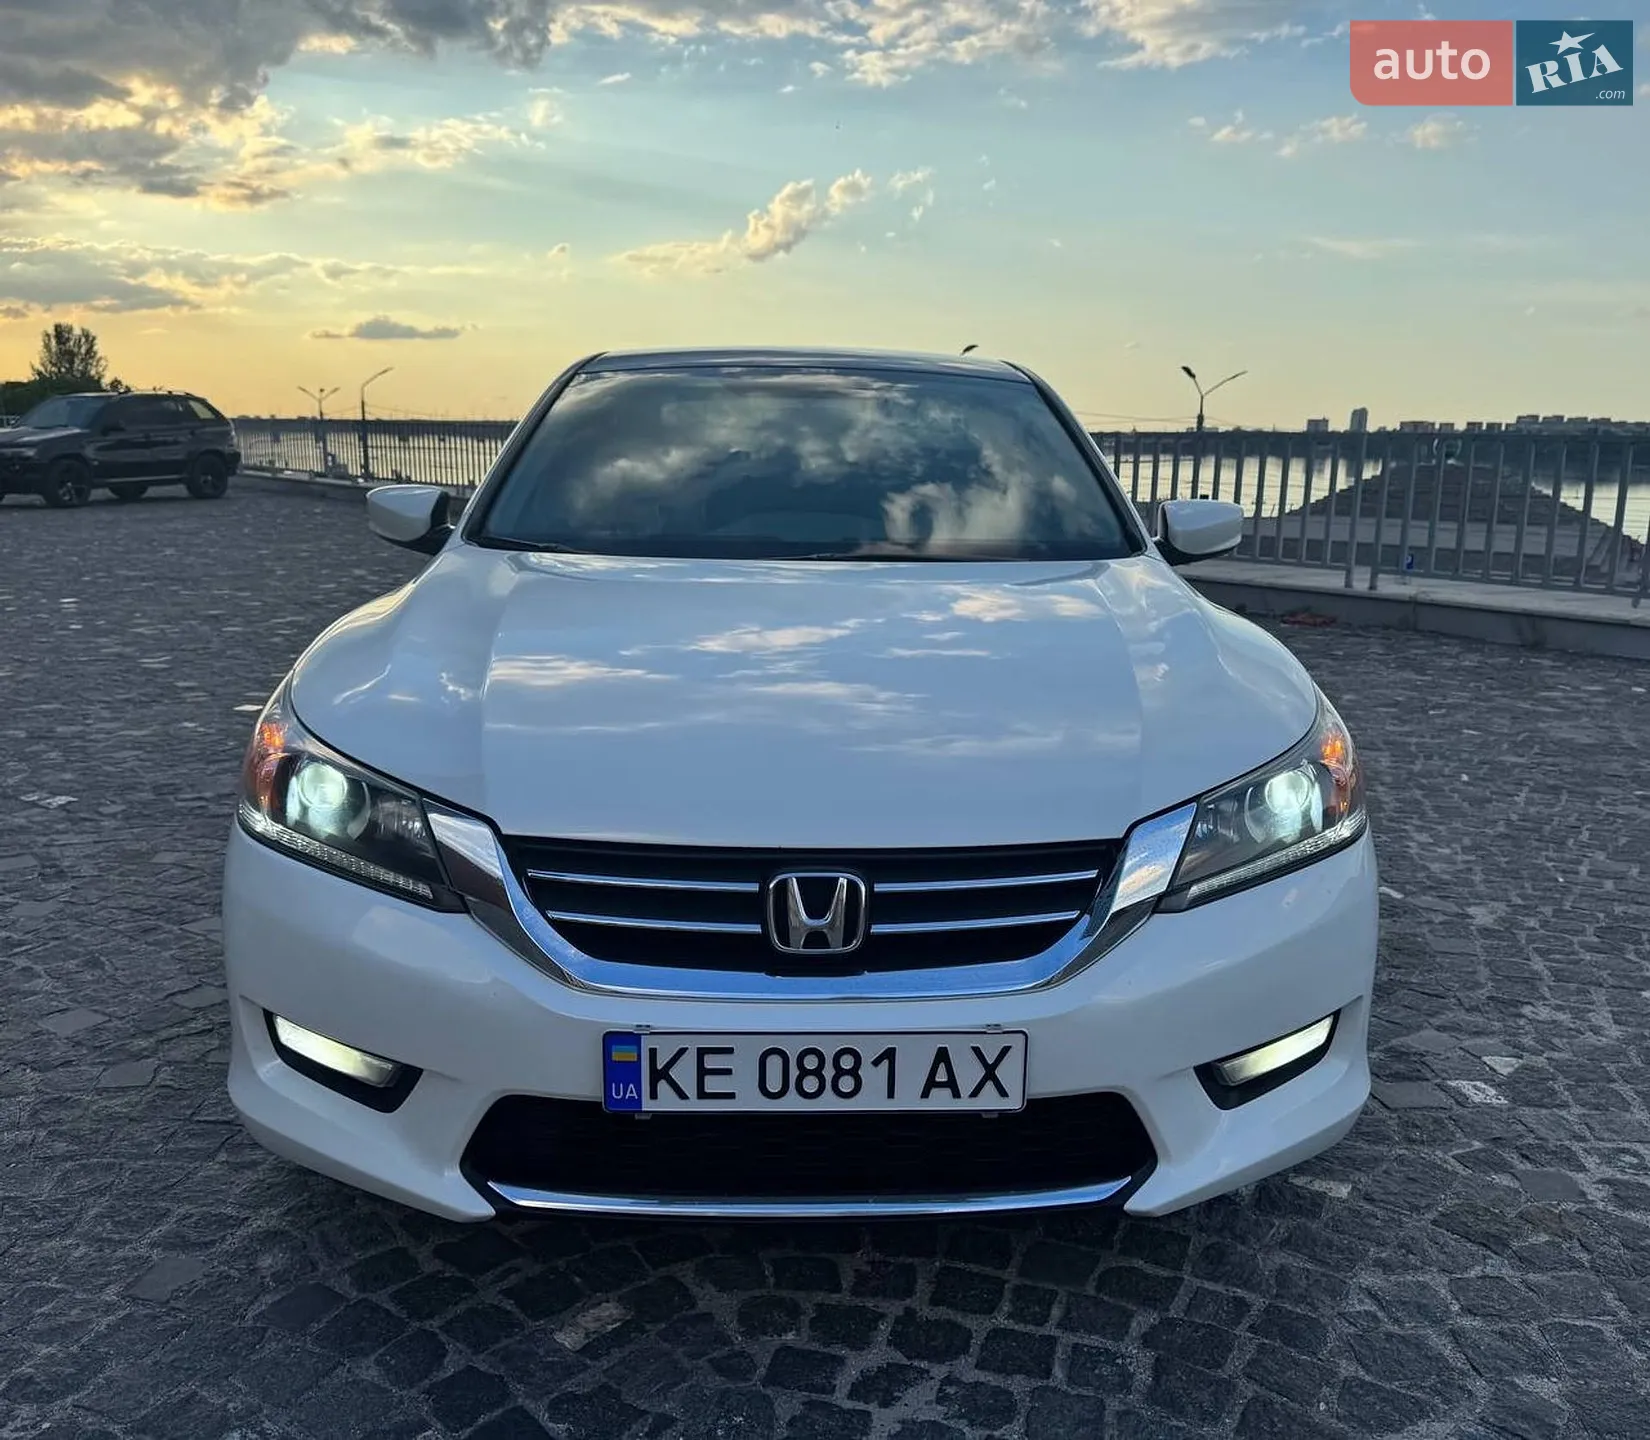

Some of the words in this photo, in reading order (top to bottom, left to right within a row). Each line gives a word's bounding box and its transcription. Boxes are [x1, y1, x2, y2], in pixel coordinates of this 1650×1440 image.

[611, 1082, 639, 1099] UA
[648, 1046, 737, 1100] KE
[757, 1046, 896, 1100] 0881
[919, 1045, 1012, 1099] AX
